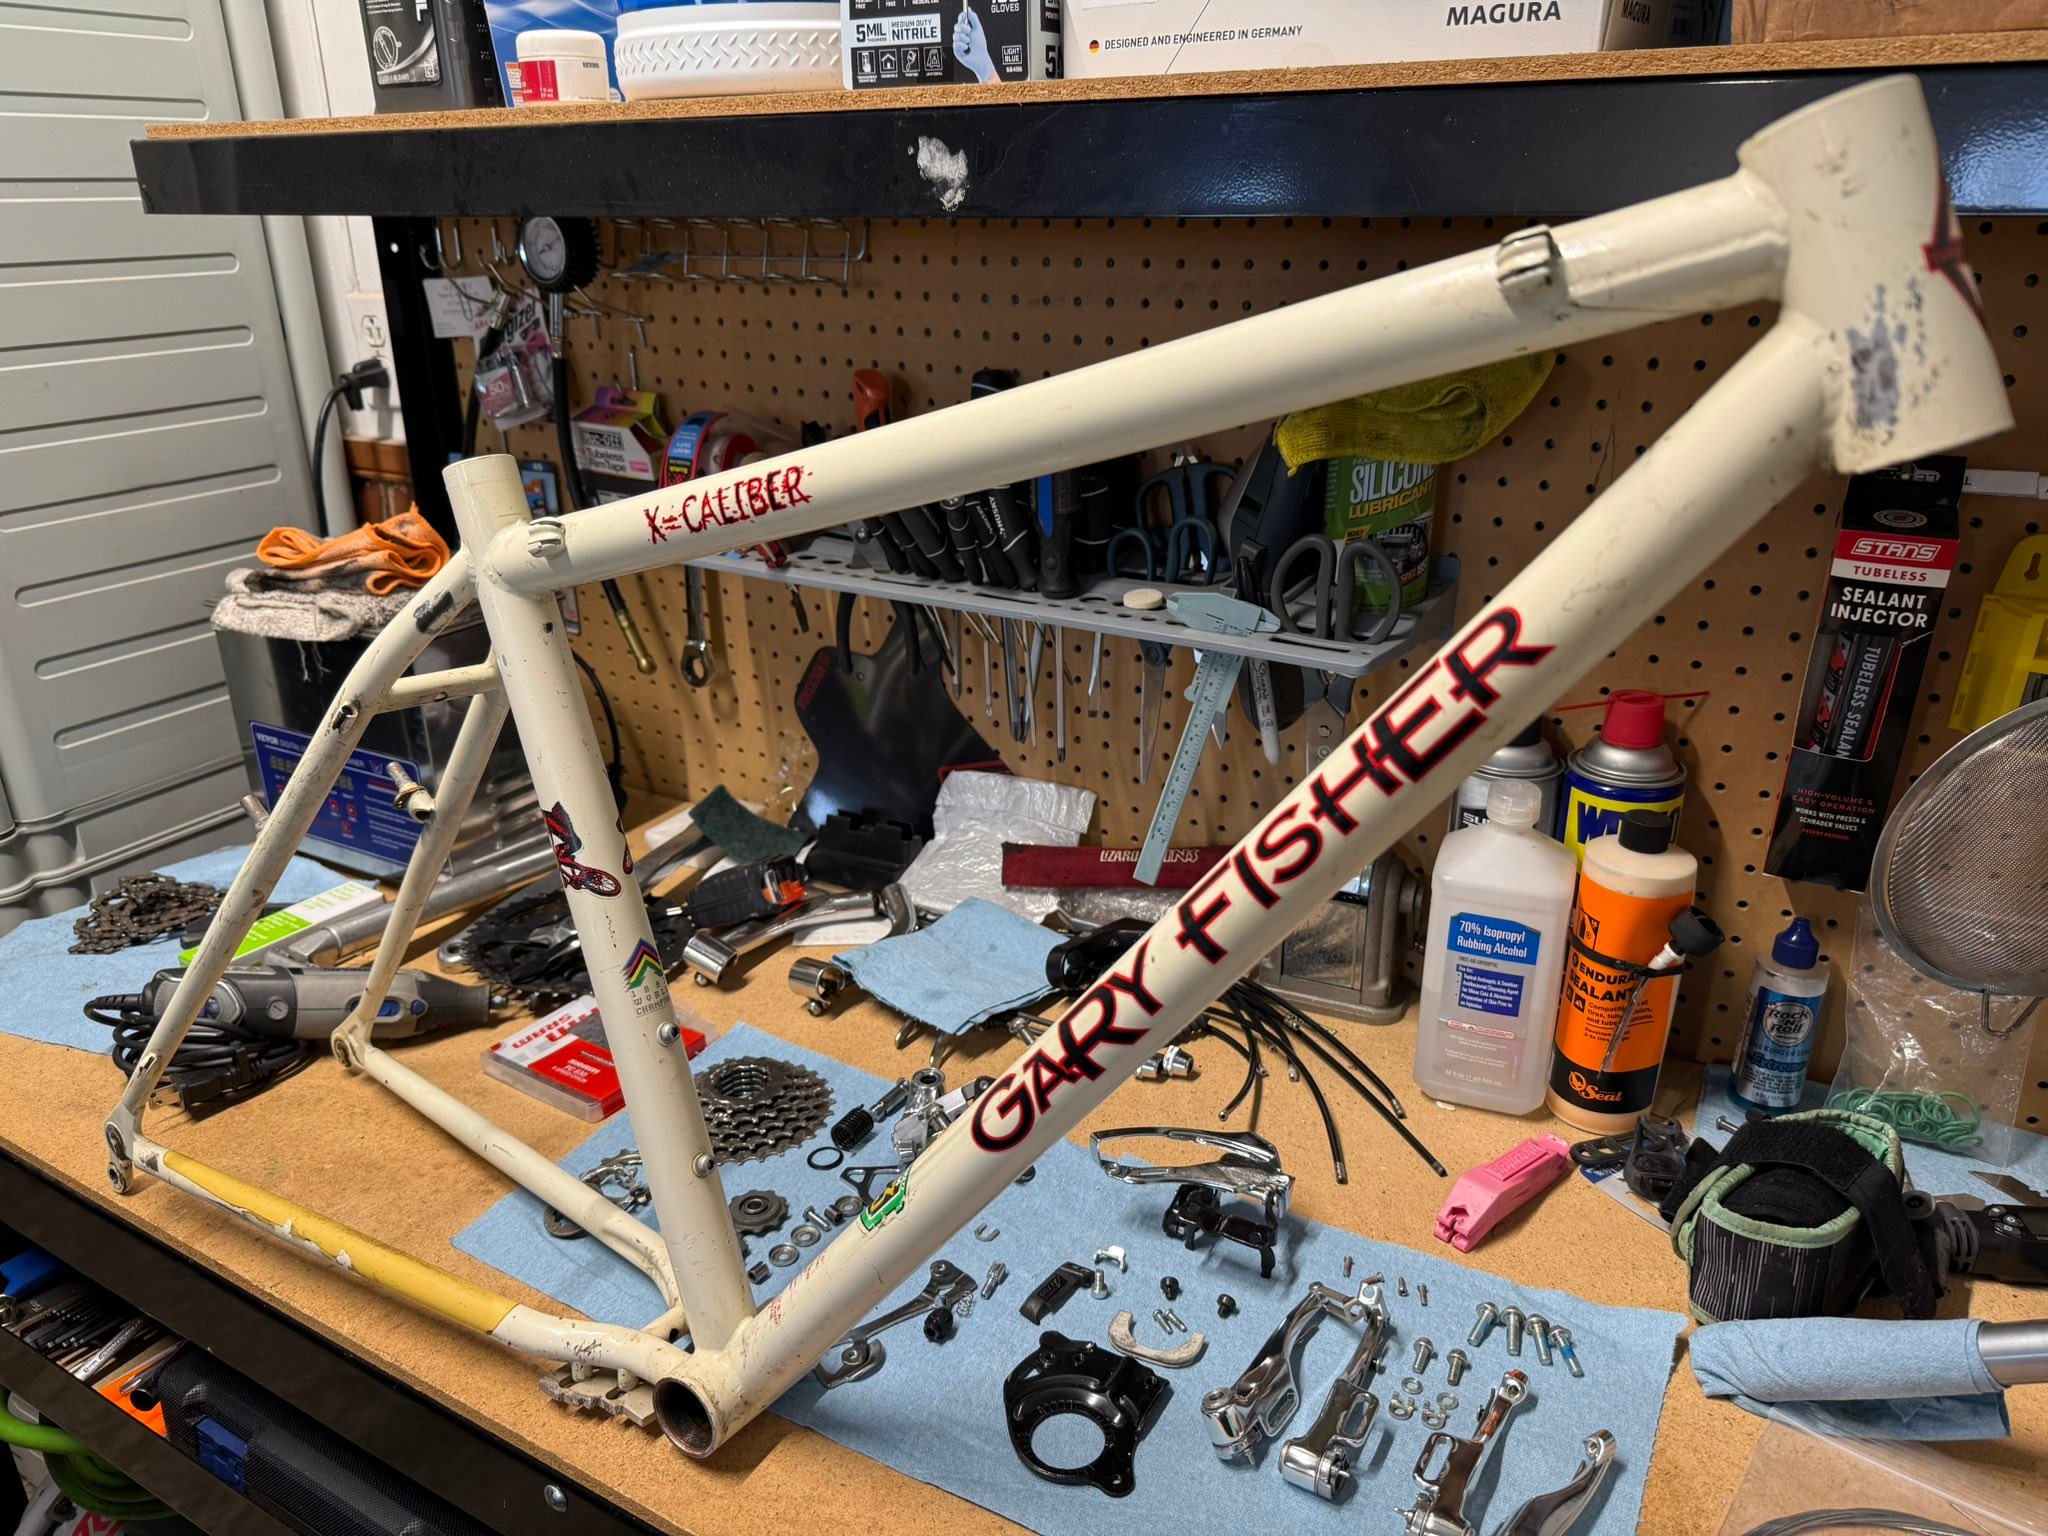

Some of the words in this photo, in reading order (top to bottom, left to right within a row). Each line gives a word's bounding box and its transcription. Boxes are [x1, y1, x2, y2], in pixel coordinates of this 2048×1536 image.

[991, 3, 1020, 13] GLOVES
[1446, 1, 1562, 27] MAGURA
[1620, 0, 1650, 25] MAGURA
[856, 24, 866, 42] 5
[866, 22, 887, 37] MIL
[891, 20, 915, 28] MEDIUM
[916, 19, 932, 27] DUTY
[891, 27, 938, 41] NITRILE
[1104, 35, 1149, 50] DESIGNED
[1151, 34, 1171, 46] AND
[1173, 30, 1236, 44] ENGINEERED
[1238, 28, 1249, 40] IN
[1251, 25, 1303, 39] GERMANY
[1003, 47, 1020, 55] LIGHT
[1350, 458, 1435, 504] SILICON
[1349, 478, 1433, 520] LUBRICANT
[989, 496, 1005, 534] HUSKY
[1853, 565, 1928, 582] TUBELESS
[1841, 586, 1927, 610] SEALANT
[1830, 602, 1929, 628] INJECTOR
[1850, 647, 1881, 708] TUBELESS
[1836, 711, 1861, 758] SEALAN
[1792, 795, 1816, 805] EASY
[1820, 801, 1876, 814] OPERATION
[1797, 788, 1864, 804] HIGH-VOLUME
[1795, 806, 1817, 817] WORKS
[1818, 811, 1834, 819] WITH
[1835, 814, 1860, 823] PRESTA
[1799, 816, 1833, 828] SCHRADER
[1834, 823, 1858, 832] VALVES
[970, 935, 1164, 1153] GARY
[1176, 605, 1556, 966] FISHER
[1459, 920, 1481, 936] 70%
[1483, 924, 1526, 944] Isopropyl
[1456, 935, 1492, 954] Rubbing
[1493, 942, 1527, 958] Alcohol
[1579, 963, 1640, 985] ENDURA
[633, 986, 667, 1006] WORL
[1588, 1001, 1626, 1013] Compatib
[1768, 1007, 1810, 1019] Rock
[1586, 1016, 1600, 1025] and
[1770, 1023, 1803, 1034] Roll
[512, 1013, 573, 1049] SRAM
[1584, 1026, 1612, 1037] Develope
[1764, 1045, 1785, 1055] KING
[1785, 1048, 1796, 1057] OF
[1578, 1084, 1623, 1102] Seal
